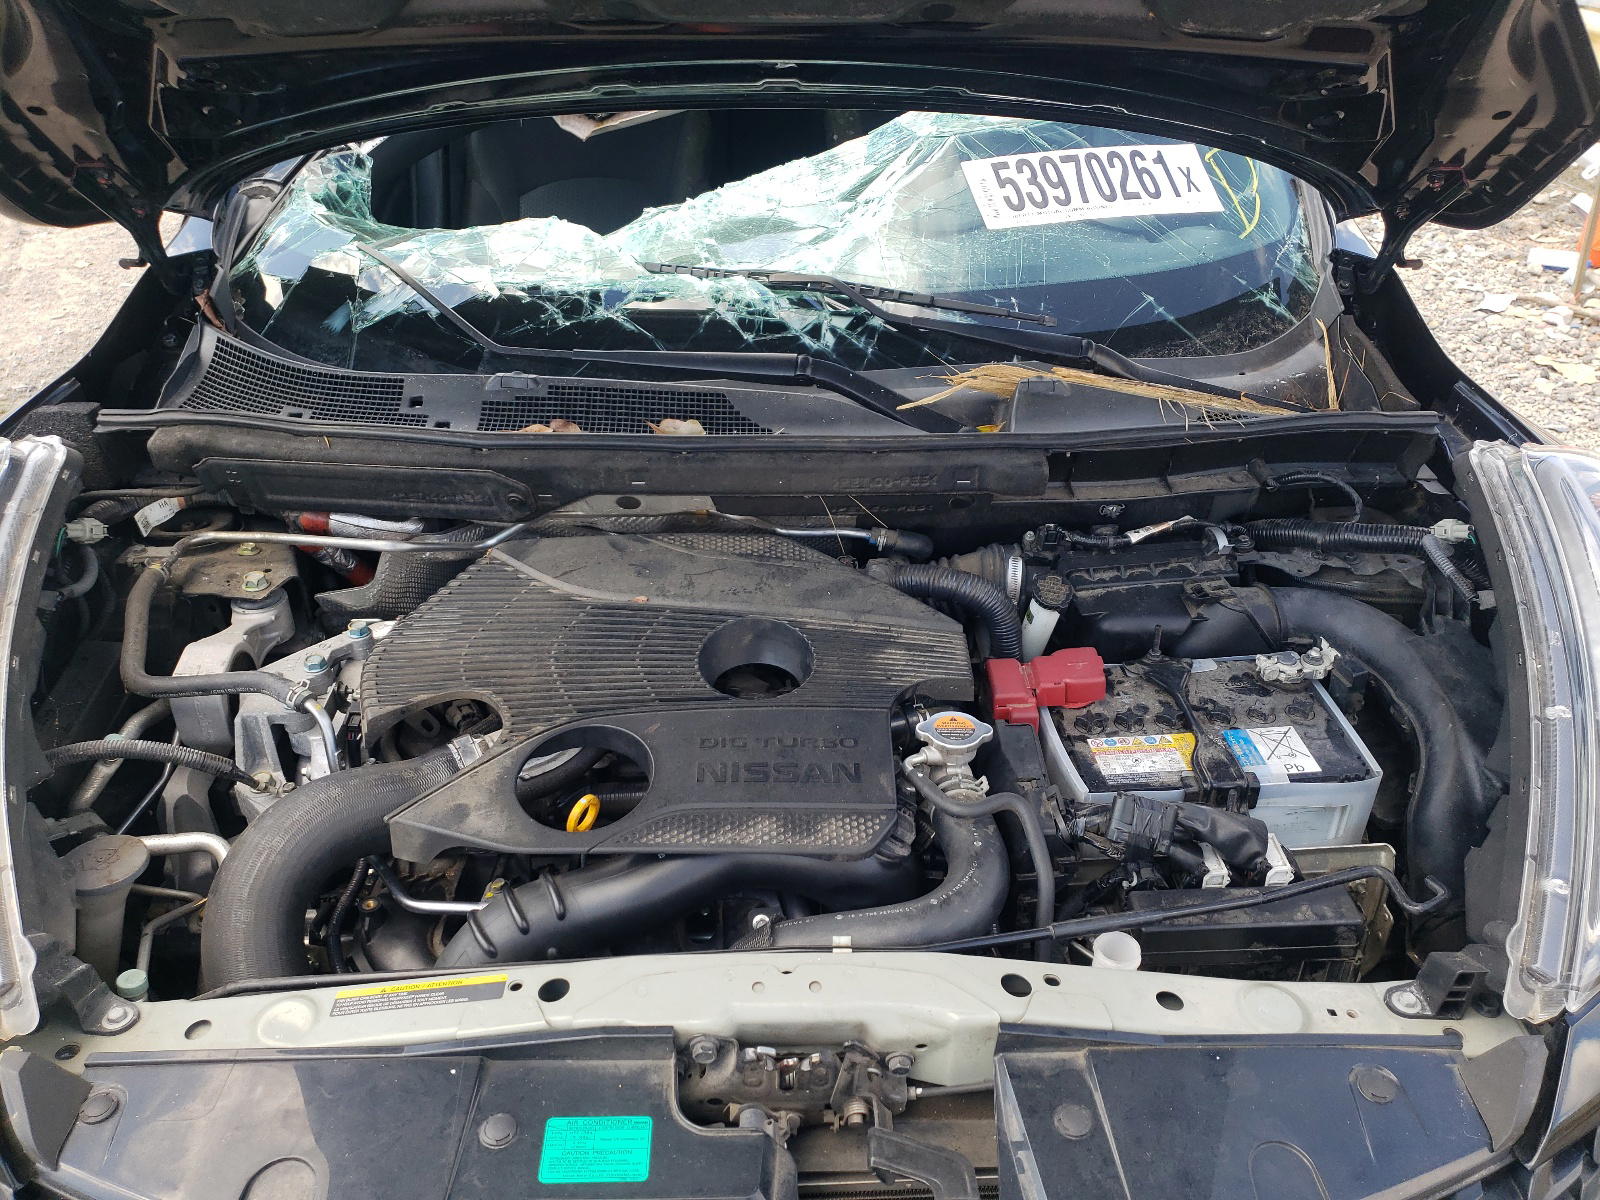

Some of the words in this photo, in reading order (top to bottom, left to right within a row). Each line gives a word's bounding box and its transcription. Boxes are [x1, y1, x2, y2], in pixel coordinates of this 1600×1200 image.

[991, 149, 1182, 212] 53970261
[755, 736, 859, 749] TURBO
[697, 761, 864, 784] NISSAN
[1284, 763, 1305, 773] Pb
[391, 984, 421, 992] CAUTION
[427, 980, 464, 988] ATTENTION
